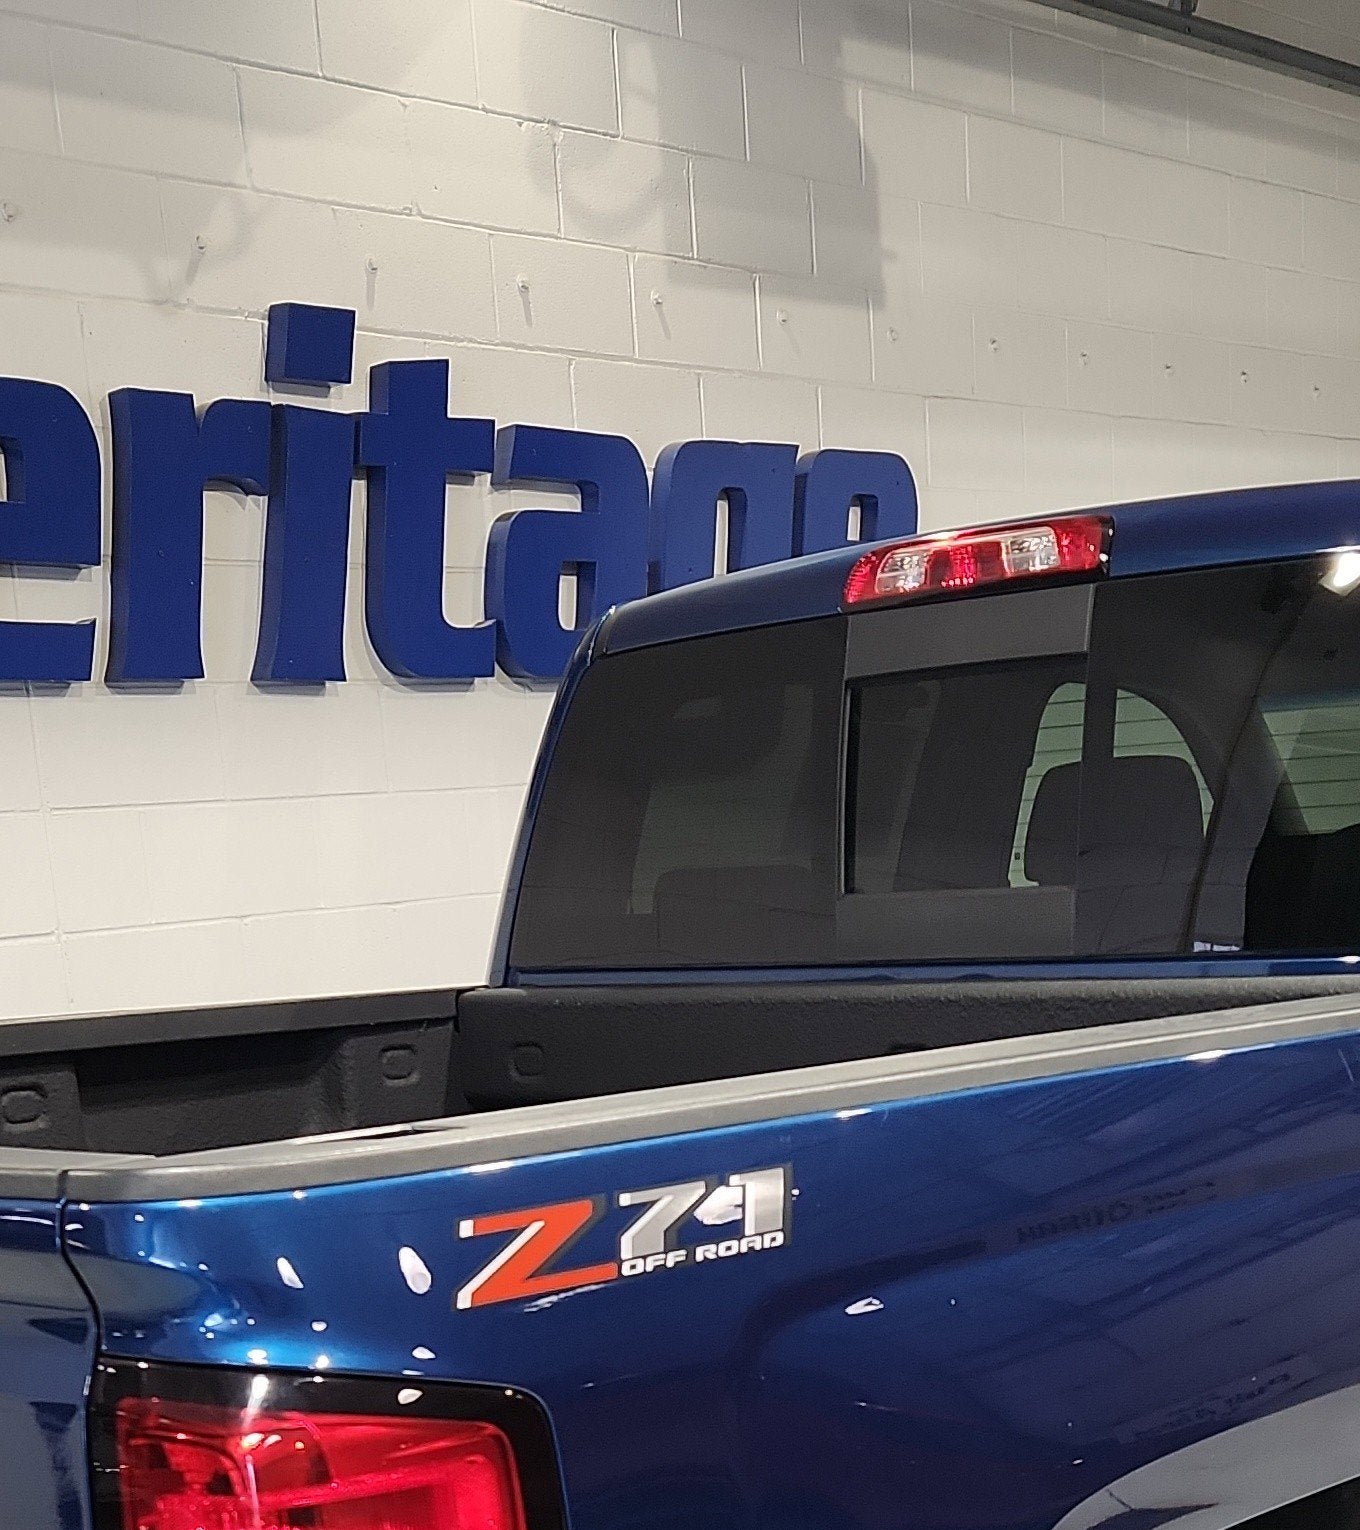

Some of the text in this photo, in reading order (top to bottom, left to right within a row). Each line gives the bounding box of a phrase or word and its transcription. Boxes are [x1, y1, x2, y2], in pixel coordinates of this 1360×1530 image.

[455, 1165, 786, 1310] Z71
[620, 1230, 786, 1277] OFF ROAD
